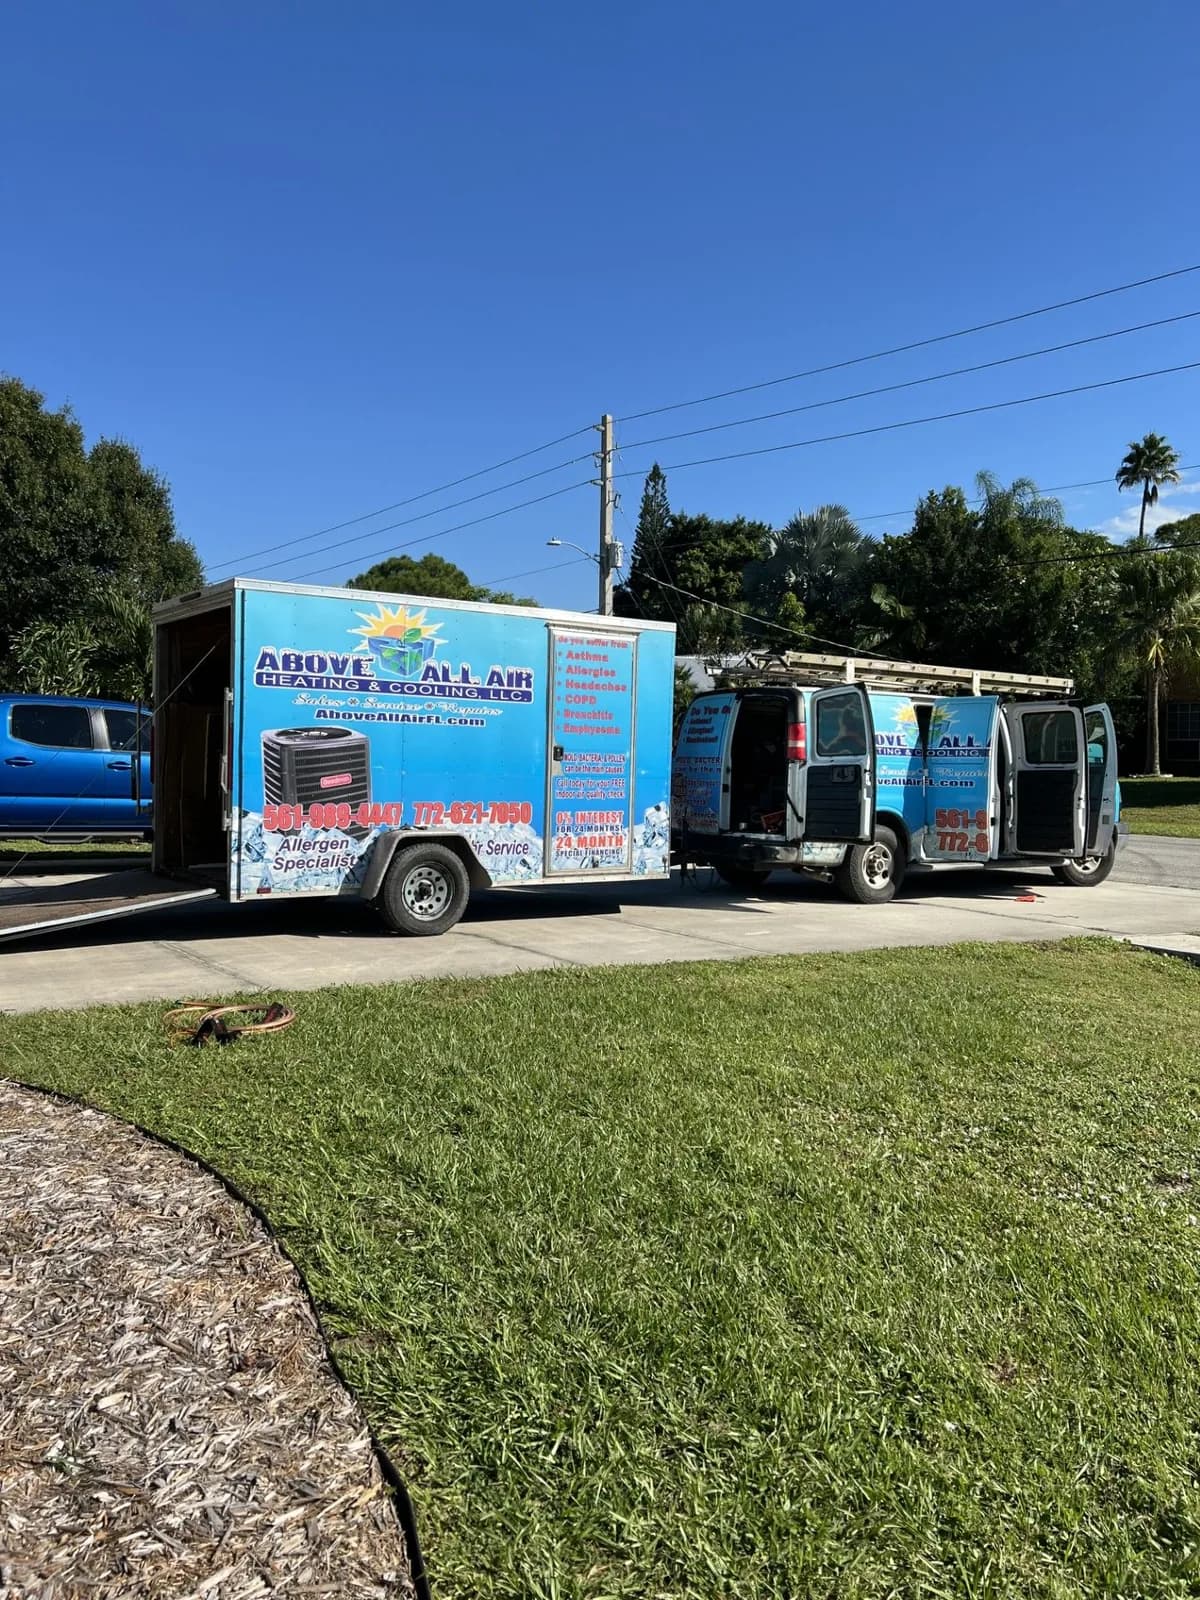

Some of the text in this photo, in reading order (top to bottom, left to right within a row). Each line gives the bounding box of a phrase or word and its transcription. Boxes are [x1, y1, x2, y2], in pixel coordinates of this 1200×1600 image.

[570, 638, 584, 646] you
[586, 639, 608, 648] suffer
[566, 651, 609, 662] Asthma
[255, 648, 533, 689] ABOVE ALL AIR
[566, 665, 616, 678] Allergies
[262, 673, 359, 690] HEATING
[368, 681, 381, 692] &
[389, 682, 482, 699] COOLING,
[565, 679, 627, 692] Headaches
[293, 692, 503, 717] Sales Service Repairs
[565, 694, 597, 705] COPD
[315, 709, 486, 727] AboveAllAirFL.com
[563, 708, 614, 721] Bronchitis
[563, 723, 621, 736] Emphysema
[938, 735, 979, 748] ALL
[569, 779, 585, 788] today
[611, 779, 625, 787] FREE
[586, 791, 606, 799] quality
[263, 801, 532, 831] 561-989-4447 772-621-7050
[556, 811, 624, 824] 0% INTEREST
[556, 824, 624, 833] FOR 24 MONTHS!
[279, 838, 350, 854] Allergen
[486, 840, 529, 856] Service
[556, 836, 624, 849] 24 MONTH
[555, 848, 624, 857] SPECIAL FINANCING!
[272, 855, 358, 872] Specialist
